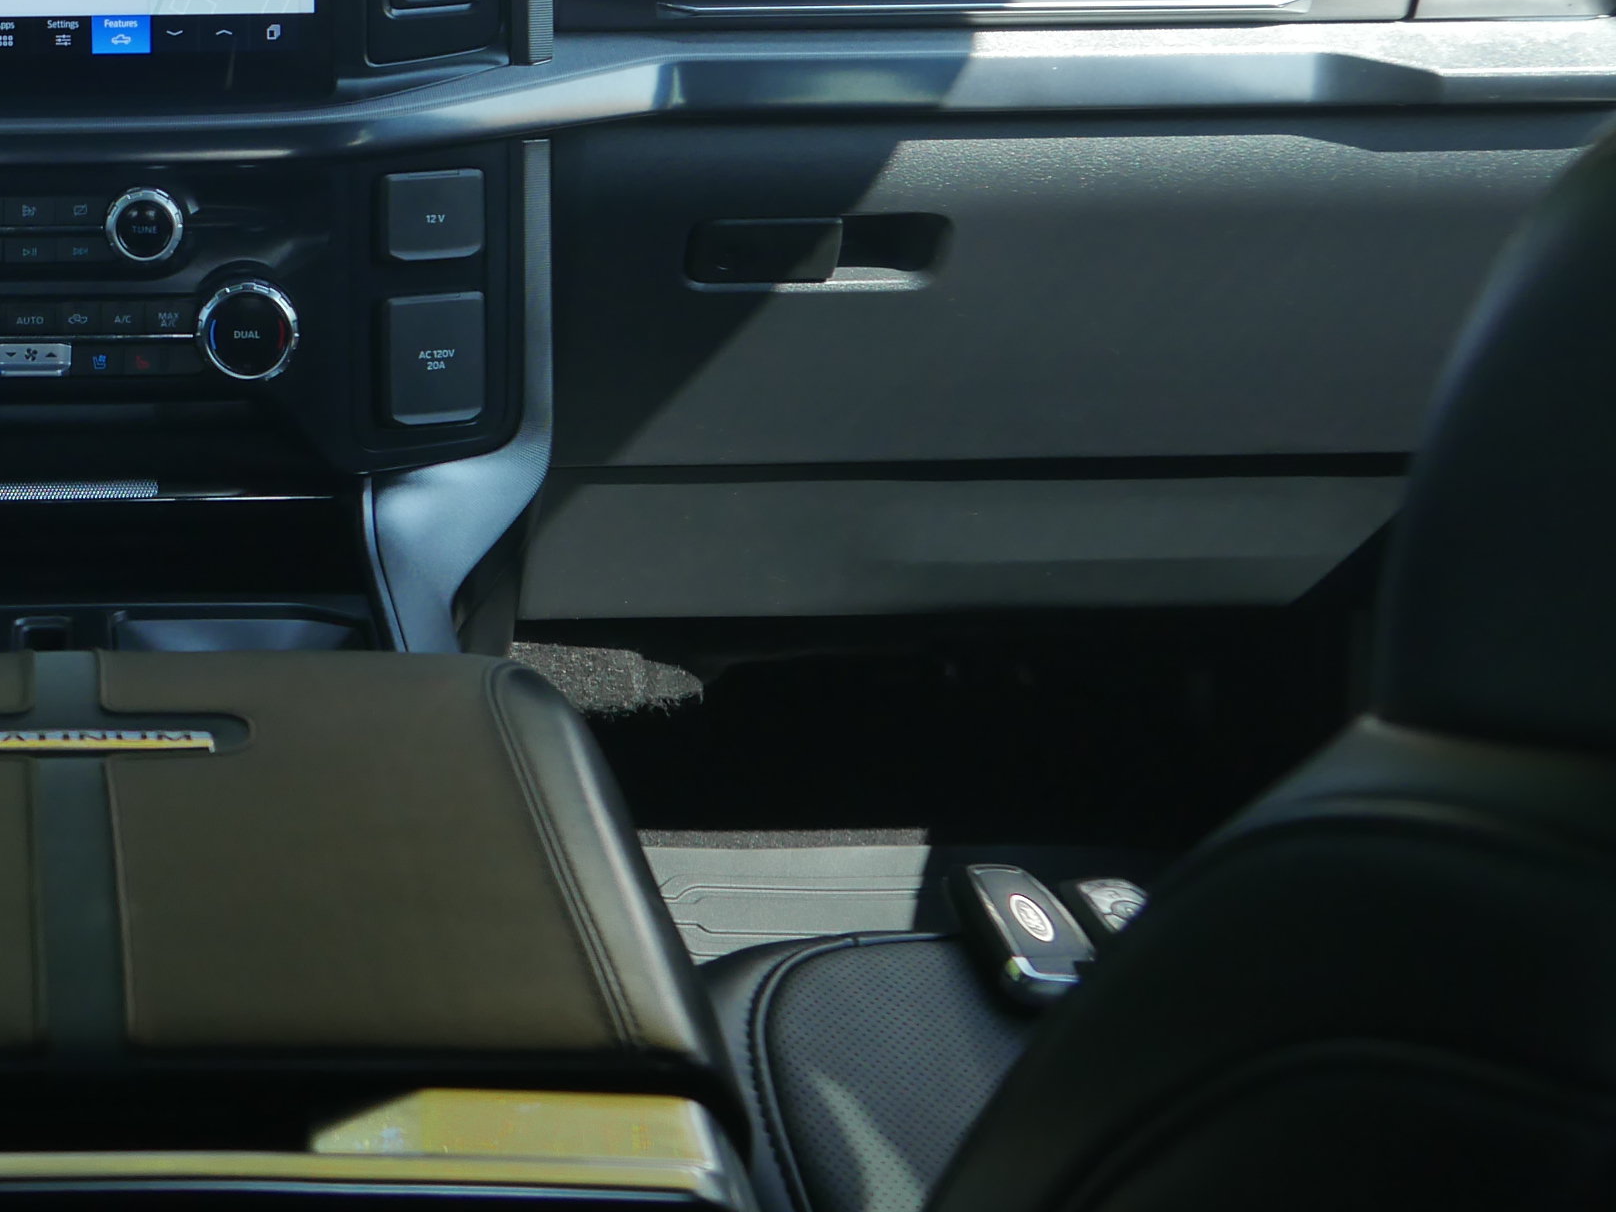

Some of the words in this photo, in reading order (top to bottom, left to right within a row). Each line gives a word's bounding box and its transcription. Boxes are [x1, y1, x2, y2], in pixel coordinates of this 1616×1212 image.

[46, 19, 80, 31] Settings
[103, 18, 138, 29] Features
[425, 214, 437, 224] 12
[438, 214, 446, 223] V
[131, 224, 158, 235] TUNE
[15, 315, 45, 326] AUTO
[114, 314, 132, 325] A/C
[157, 311, 180, 321] MAX
[160, 319, 178, 328] A/C
[232, 329, 261, 340] DUAL
[418, 350, 432, 360] AC
[433, 348, 455, 359] 120V
[426, 360, 447, 371] 20A
